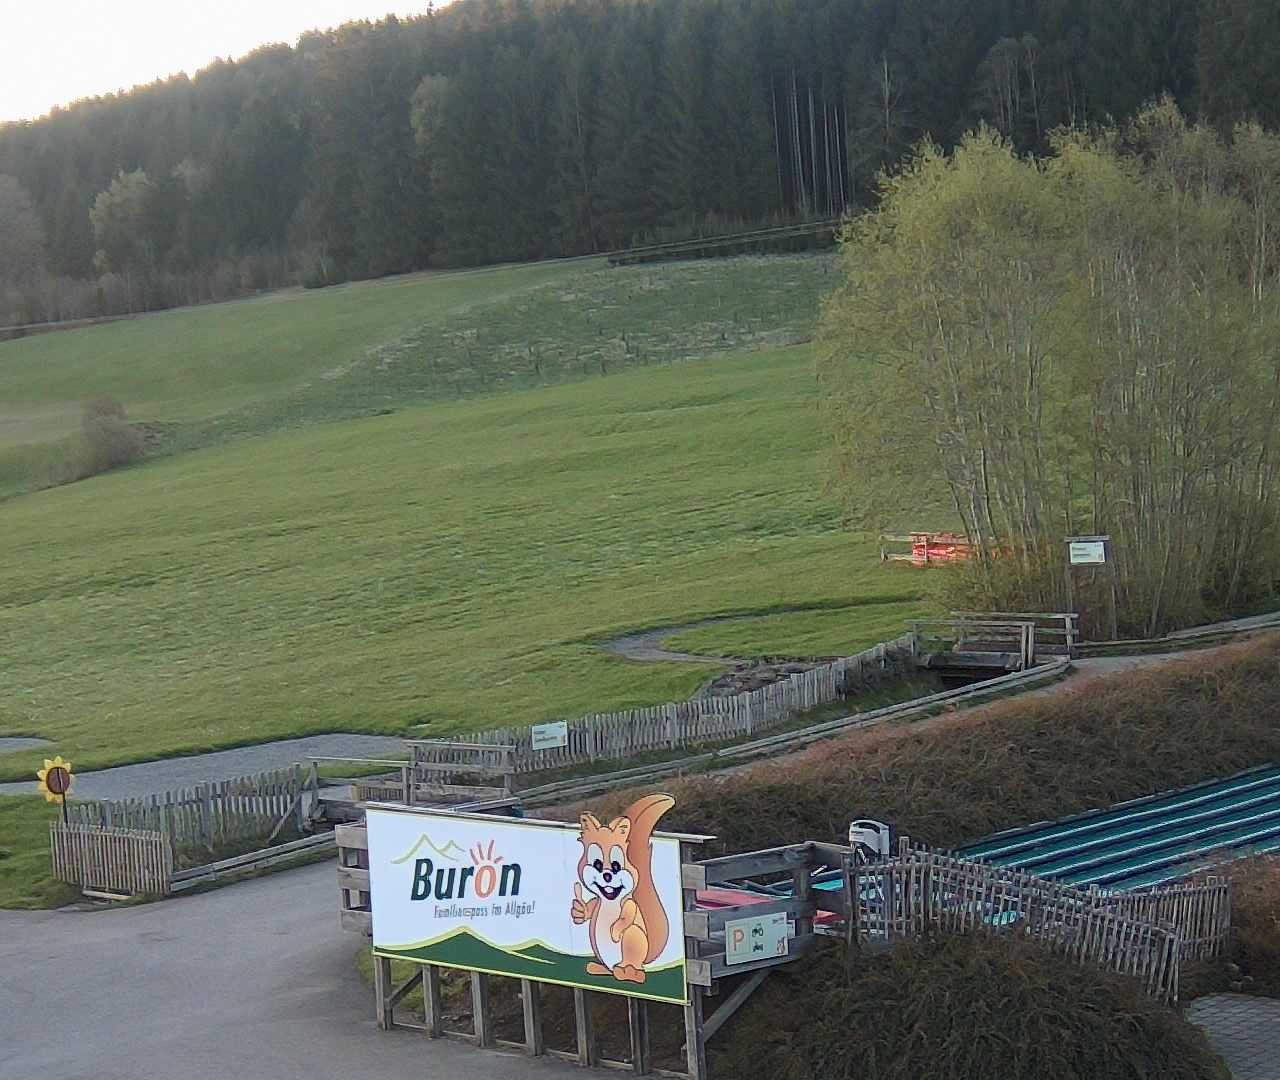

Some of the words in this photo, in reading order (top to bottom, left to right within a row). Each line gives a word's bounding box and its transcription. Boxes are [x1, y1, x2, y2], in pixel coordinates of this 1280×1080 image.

[411, 858, 522, 901] Buron
[433, 904, 489, 920] Familipass
[732, 928, 745, 952] P
